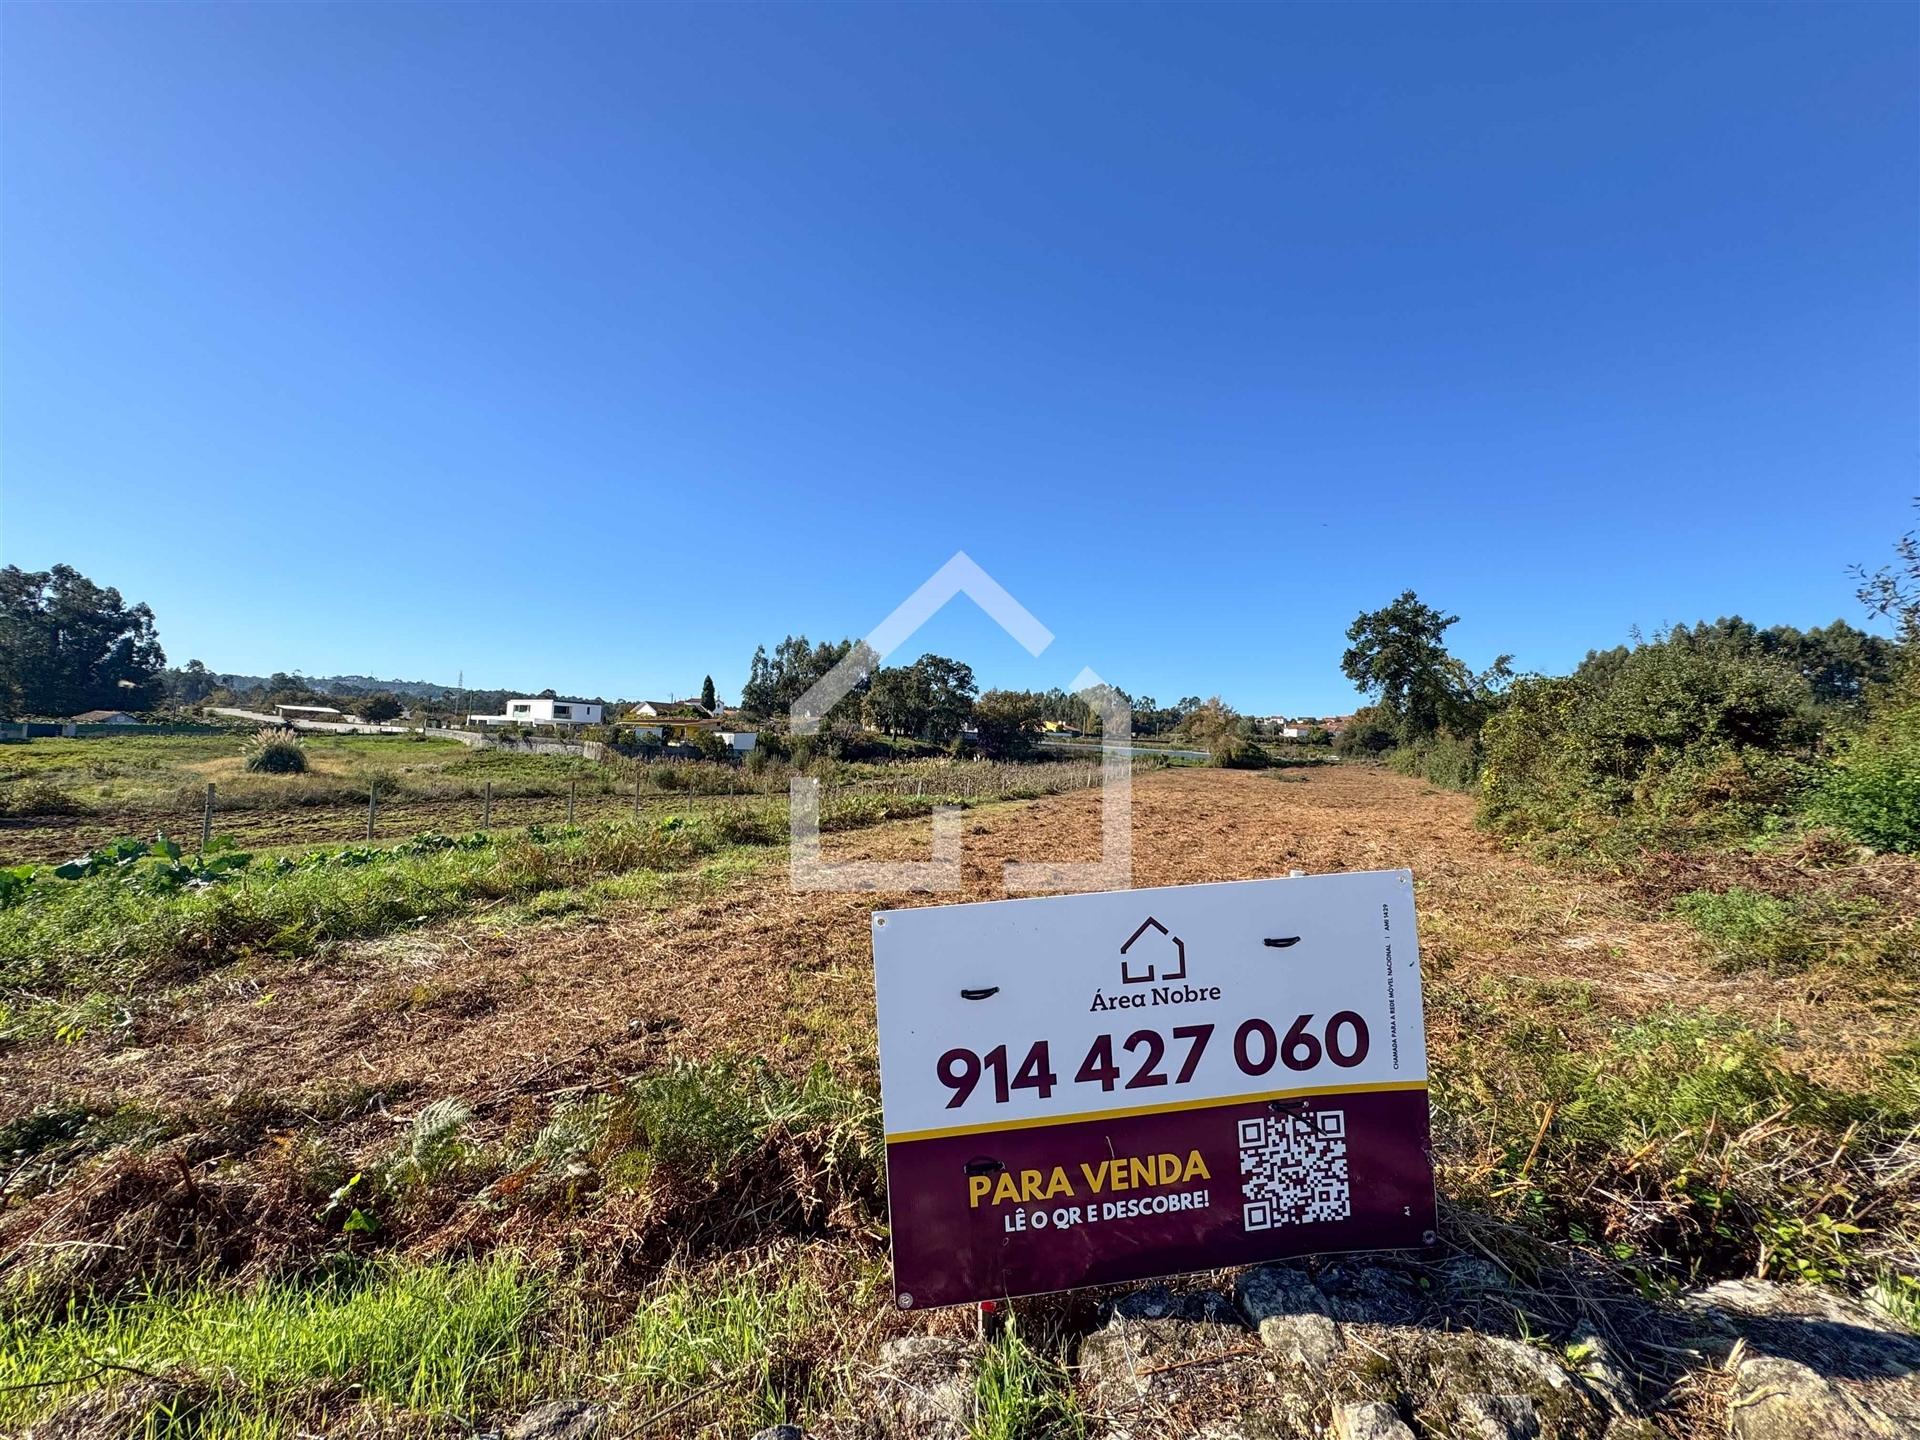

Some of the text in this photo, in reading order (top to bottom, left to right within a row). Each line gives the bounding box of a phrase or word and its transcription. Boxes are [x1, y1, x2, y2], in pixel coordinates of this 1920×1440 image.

[1385, 944, 1393, 976] NACIONAL
[1089, 984, 1222, 1012] Área Nobre
[1387, 977, 1395, 998] MÓVEL
[936, 1010, 1370, 1109] 914 427 060
[968, 1149, 1212, 1208] PARA VENDA
[1004, 1189, 1211, 1233] LÊ O QR E DESCOBRE!
